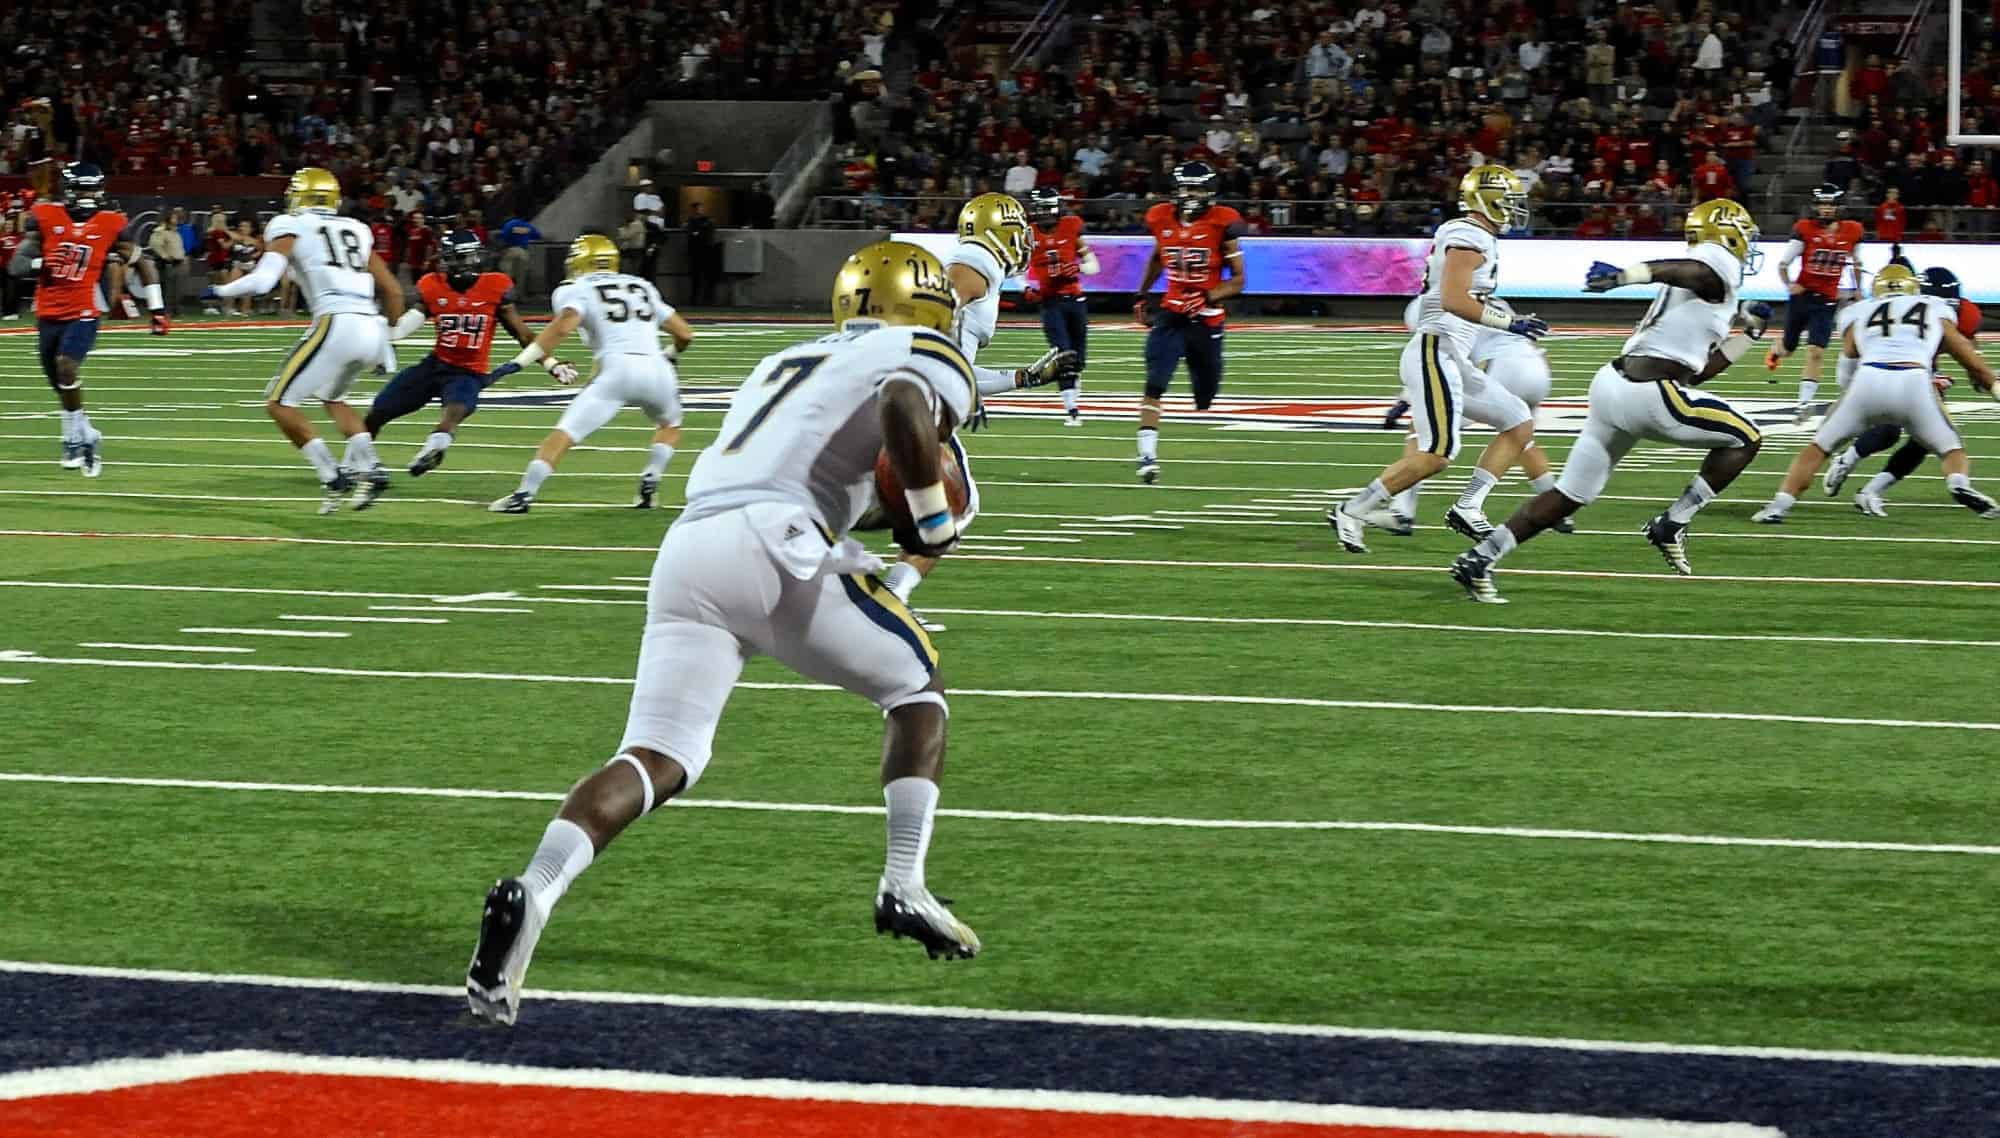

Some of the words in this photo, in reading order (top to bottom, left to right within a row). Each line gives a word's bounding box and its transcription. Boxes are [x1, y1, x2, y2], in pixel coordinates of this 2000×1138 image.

[317, 225, 364, 271] 18
[594, 283, 656, 323] 53
[855, 287, 872, 316] 7
[1865, 301, 1930, 339] 44
[438, 313, 488, 349] 24
[721, 352, 833, 455] 7
